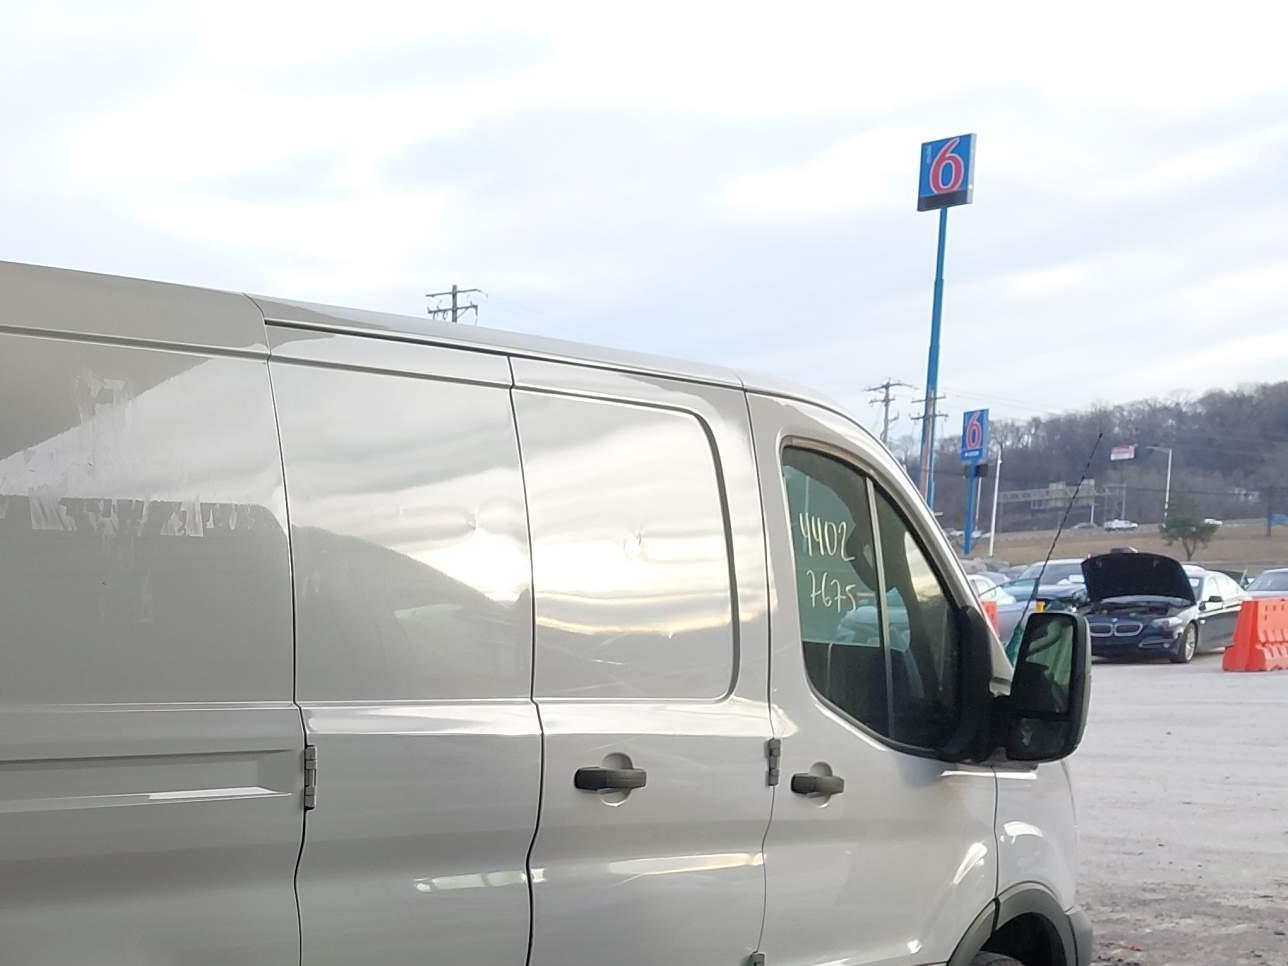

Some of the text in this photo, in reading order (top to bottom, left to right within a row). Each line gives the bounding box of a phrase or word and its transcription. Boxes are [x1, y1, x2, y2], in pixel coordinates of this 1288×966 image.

[929, 137, 964, 195] 6
[965, 412, 982, 449] 6
[799, 512, 856, 561] 4402
[806, 569, 857, 613] 7675
